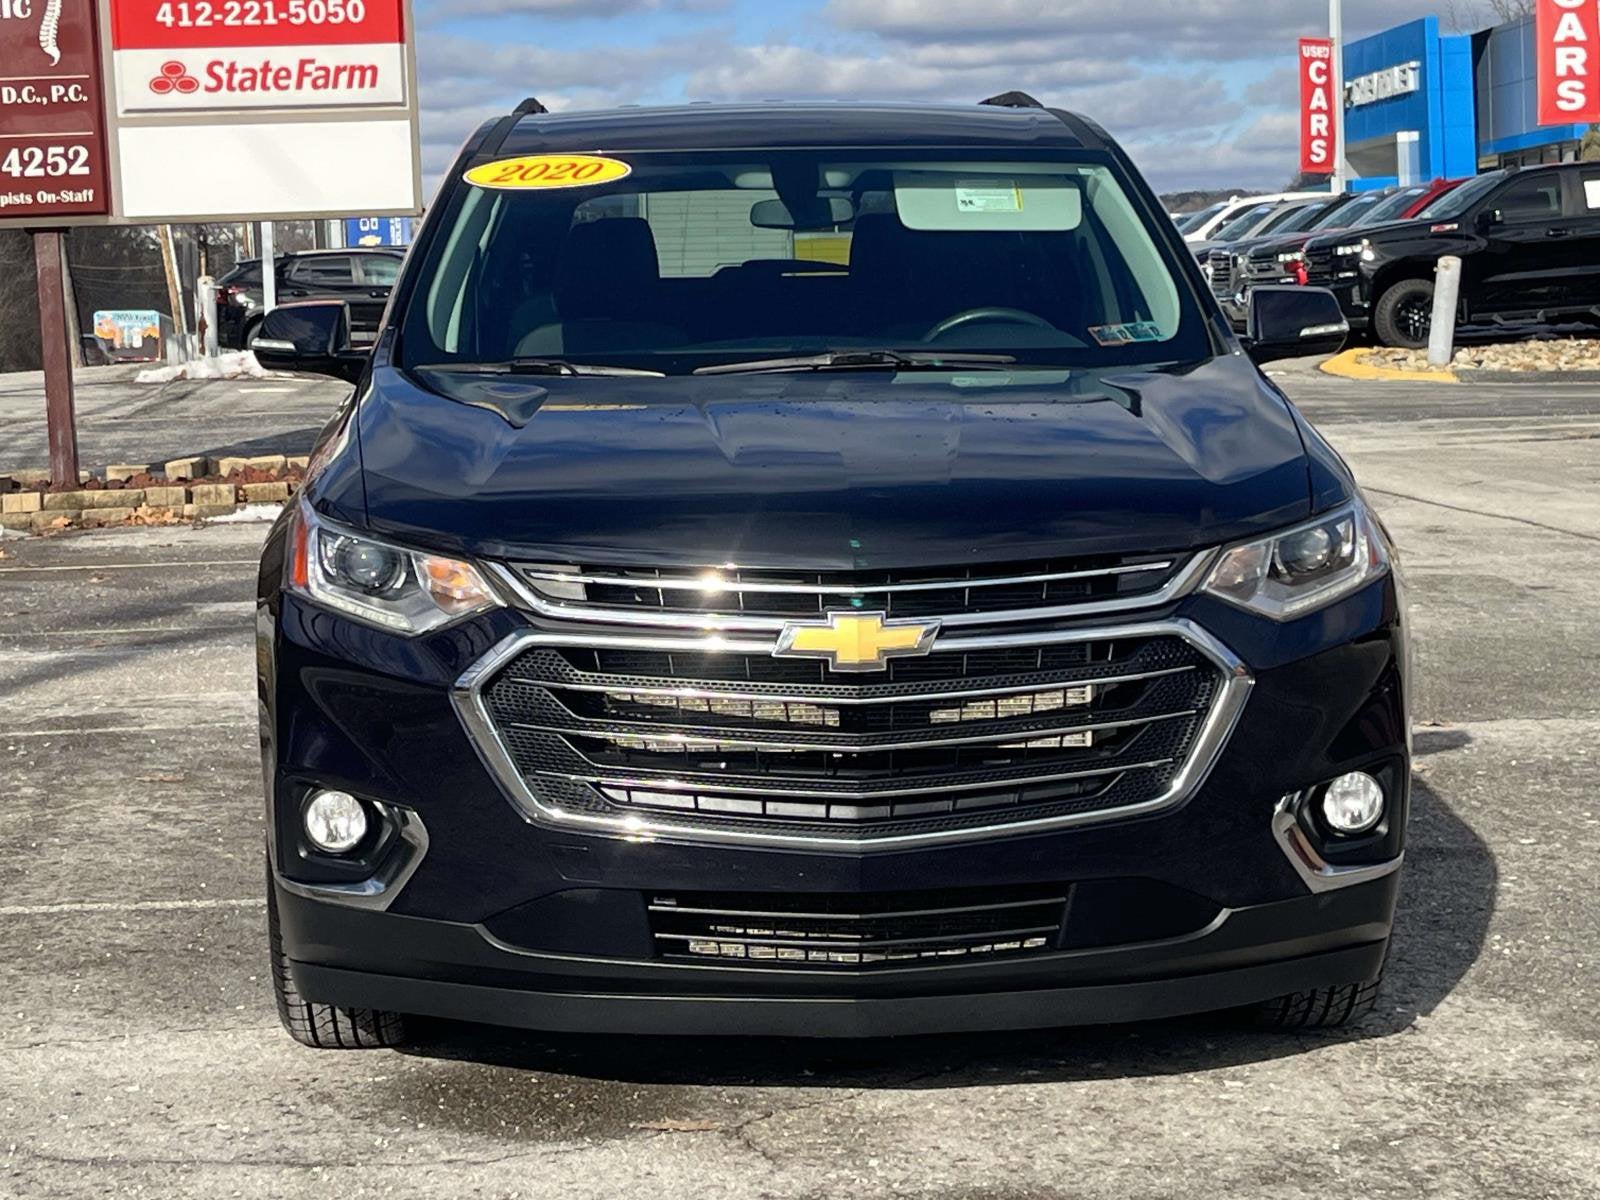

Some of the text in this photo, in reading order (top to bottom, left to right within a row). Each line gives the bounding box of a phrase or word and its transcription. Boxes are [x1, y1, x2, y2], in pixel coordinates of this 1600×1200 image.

[155, 0, 366, 28] 412-221-5050
[1301, 45, 1330, 59] USED
[1553, 0, 1588, 112] ARS
[1, 84, 89, 105] D.C., P.C.
[1308, 60, 1329, 164] CARS
[1, 145, 90, 177] 4252
[490, 162, 604, 183] 2020
[36, 189, 94, 204] On-Staff
